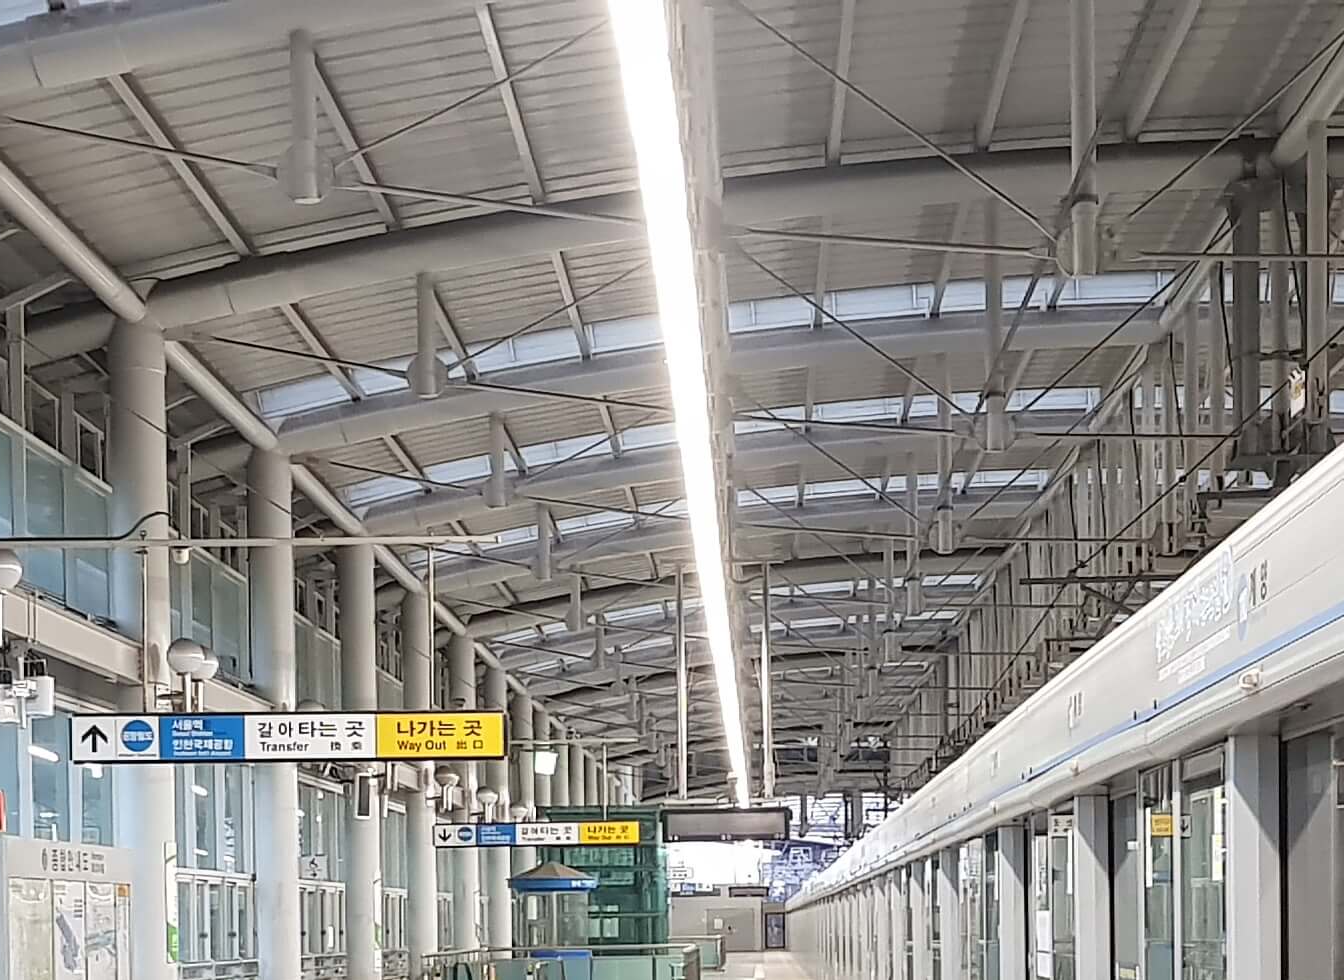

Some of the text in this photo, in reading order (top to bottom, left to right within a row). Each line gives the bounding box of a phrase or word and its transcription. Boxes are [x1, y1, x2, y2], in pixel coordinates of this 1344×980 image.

[172, 719, 204, 731] 서울역
[257, 720, 366, 738] 갈아타는 곳
[396, 719, 483, 738] 나가는 곳
[260, 741, 310, 752] Transfer
[397, 740, 447, 753] Way Out
